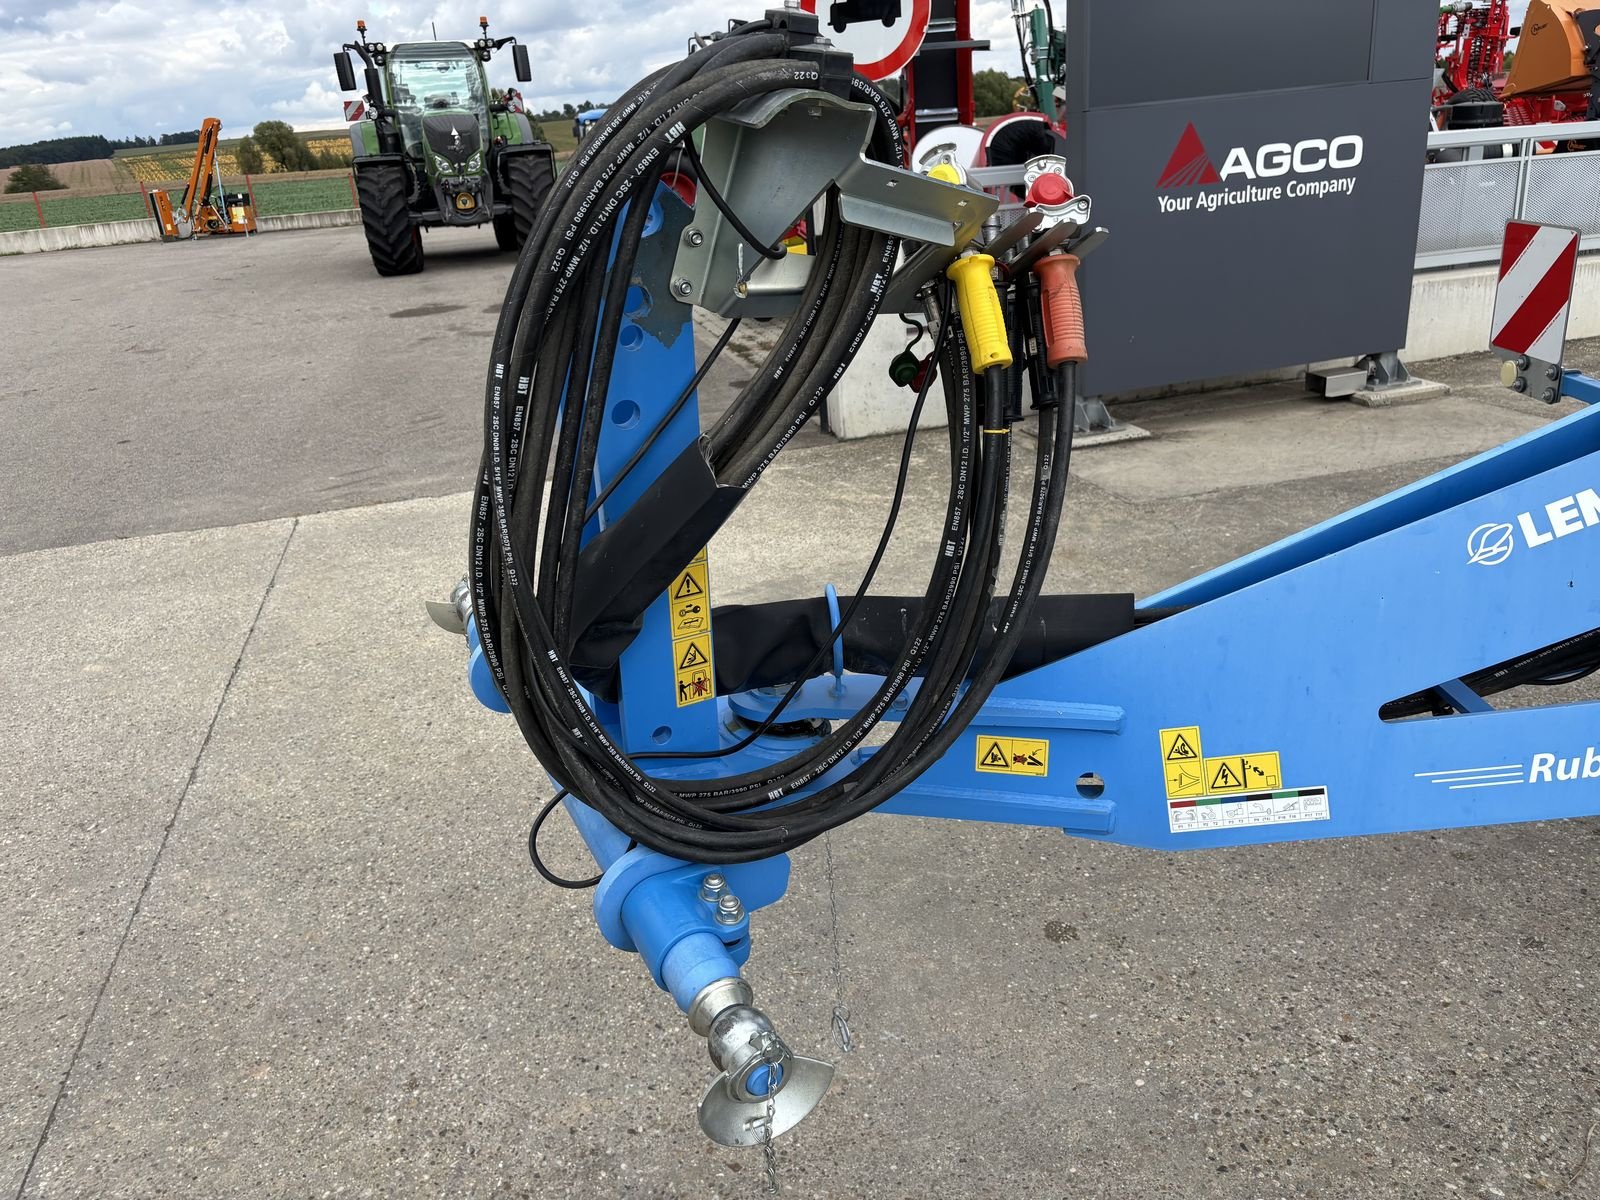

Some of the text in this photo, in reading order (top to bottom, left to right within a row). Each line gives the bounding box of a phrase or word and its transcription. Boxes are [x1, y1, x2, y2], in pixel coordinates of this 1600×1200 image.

[851, 77, 881, 103] BAR/39
[622, 102, 637, 118] MWP
[879, 101, 892, 117] 275
[664, 120, 687, 144] HBT
[887, 118, 900, 140] MWP
[579, 154, 591, 167] PSI
[616, 141, 635, 164] MWP
[634, 147, 660, 176] EN857
[1220, 135, 1363, 182] AGCO
[601, 162, 617, 180] 275
[616, 179, 632, 199] 2SC
[1158, 177, 1356, 213] Your Agriculture Company
[573, 179, 604, 223] BAR/3990
[598, 197, 618, 222] DN12
[564, 223, 578, 241] PSI
[565, 255, 580, 278] MWP
[870, 234, 895, 294] HBT EN857
[555, 278, 568, 295] 275
[495, 363, 504, 379] HBT
[960, 346, 971, 386] BAR/3990
[517, 376, 530, 395] HBT
[492, 415, 500, 430] 2SC
[512, 405, 524, 431] EN857
[963, 402, 971, 425] MWP
[509, 438, 519, 455] 2SC
[742, 472, 757, 489] MWP
[757, 460, 770, 473] 275
[768, 425, 797, 459] BAR/3990
[795, 411, 807, 425] PSI
[507, 457, 517, 478] DN12
[959, 461, 968, 482] DN12
[957, 484, 966, 500] 2SC
[479, 495, 489, 521] EN857
[951, 506, 962, 532] EN857
[476, 527, 484, 543] 2SC
[475, 545, 483, 567] DN12
[944, 540, 957, 557] HBT
[477, 598, 487, 617] MWP
[928, 624, 939, 641] MWP
[941, 576, 957, 610] BAR/3990
[952, 562, 960, 575] PSI
[480, 618, 489, 632] 275
[483, 633, 499, 667] BAR/3990
[494, 667, 505, 680] PSI
[547, 649, 559, 663] HBT
[598, 733, 610, 747] MWP
[768, 787, 785, 801] HBT
[790, 773, 811, 790] EN857
[815, 762, 829, 777] 2SC
[827, 748, 845, 764] DN12
[863, 713, 877, 729] MWP
[875, 702, 886, 714] 275
[883, 671, 905, 702] BAR/3990
[902, 659, 912, 672] PSI
[1529, 746, 1600, 783] Rub
